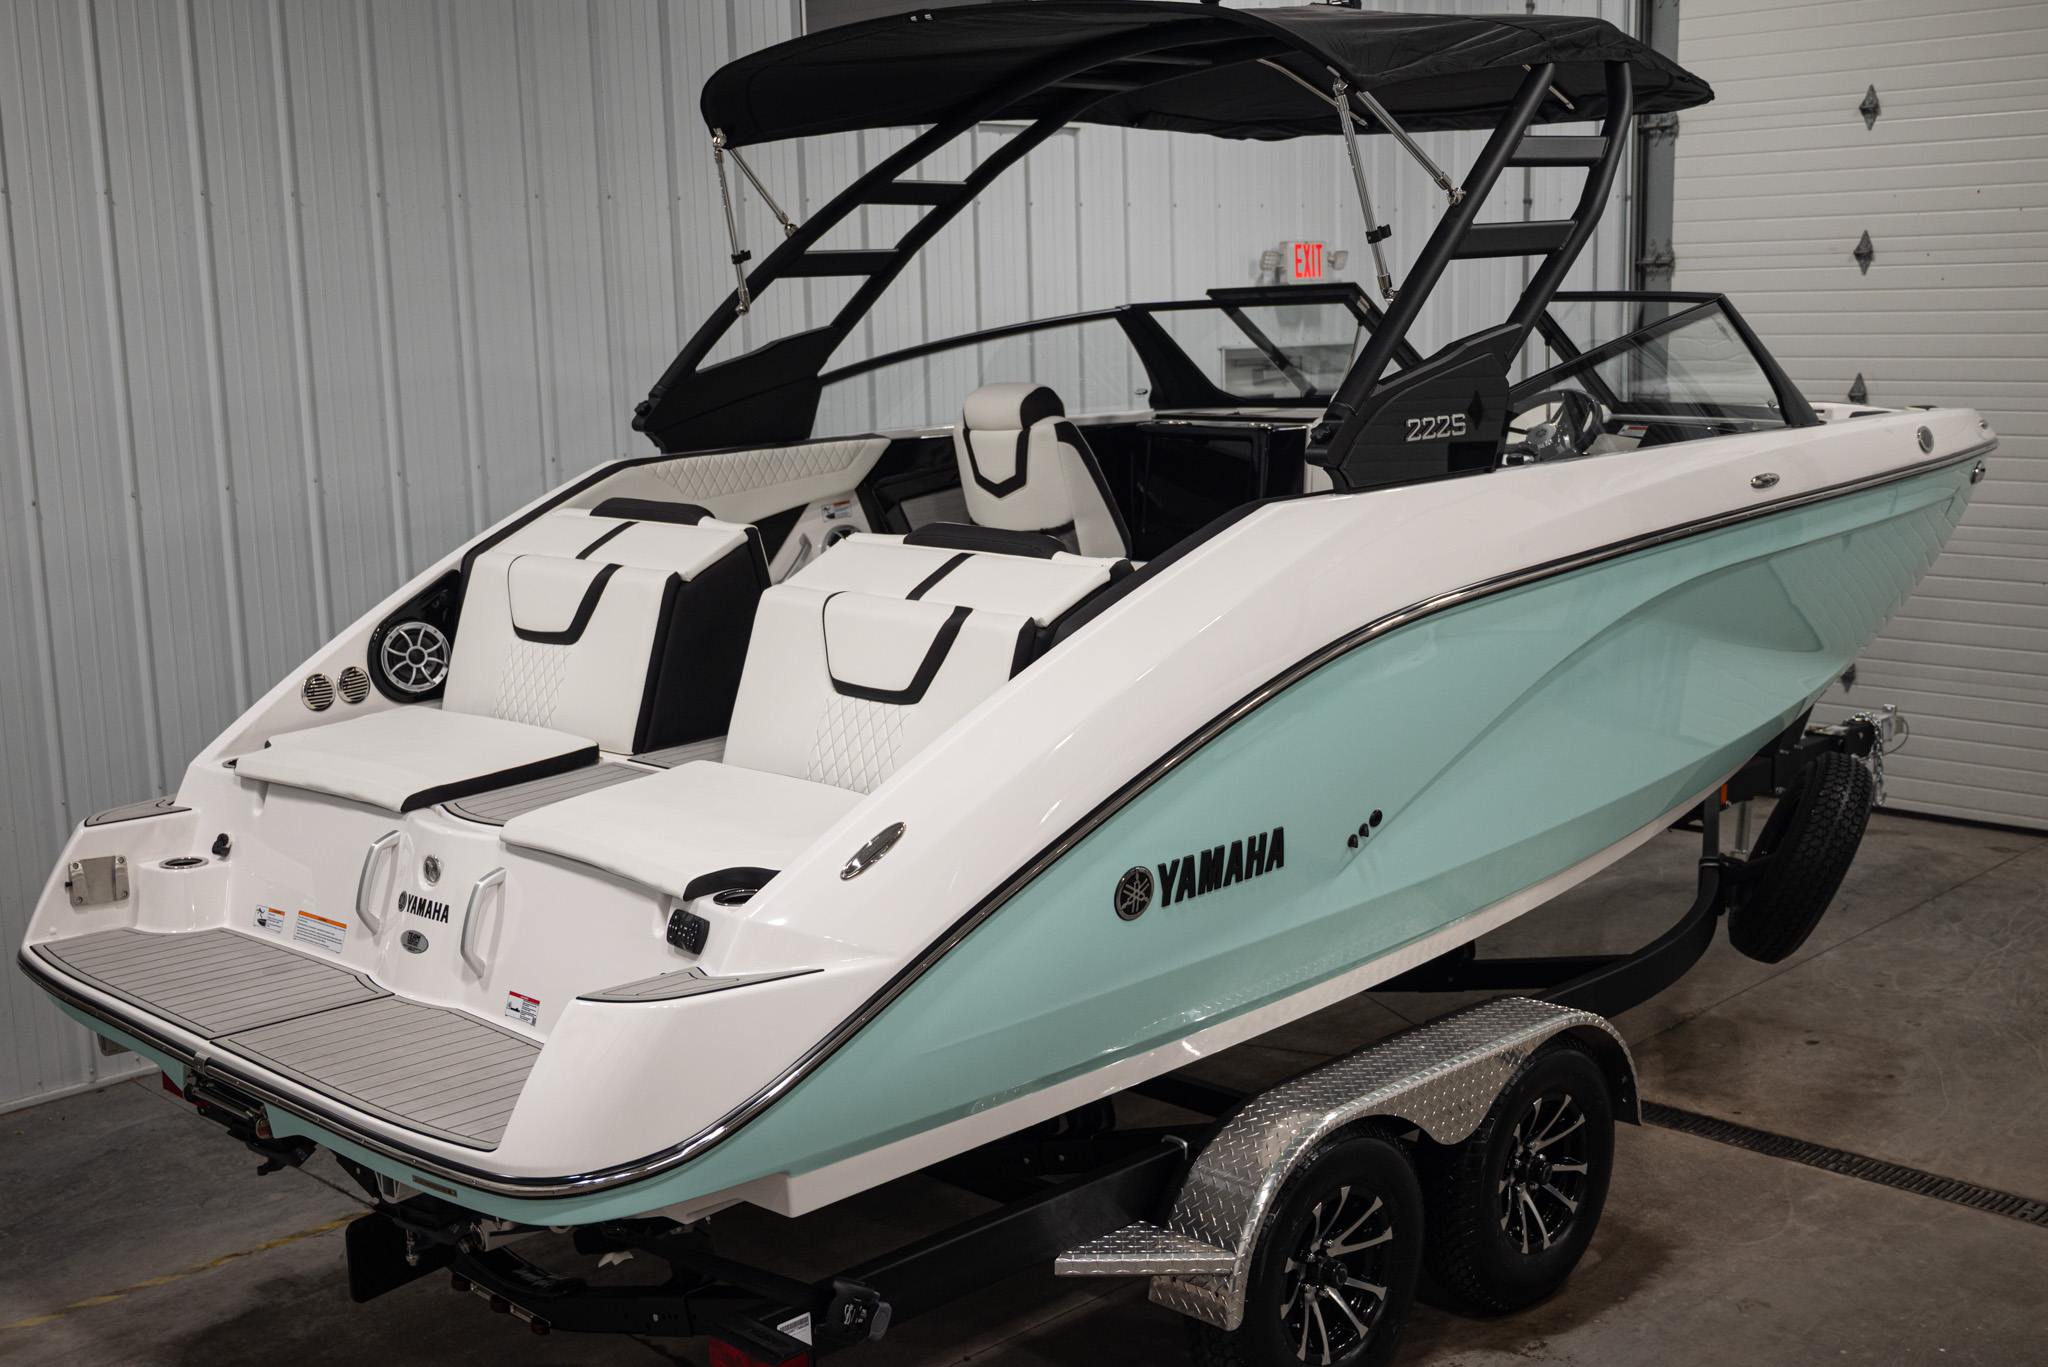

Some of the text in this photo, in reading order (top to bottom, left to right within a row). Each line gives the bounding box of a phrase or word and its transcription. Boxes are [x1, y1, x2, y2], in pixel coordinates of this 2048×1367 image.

[1294, 243, 1323, 279] EXIT
[1157, 826, 1284, 908] YAMAHA
[406, 893, 449, 924] YAMAHA
